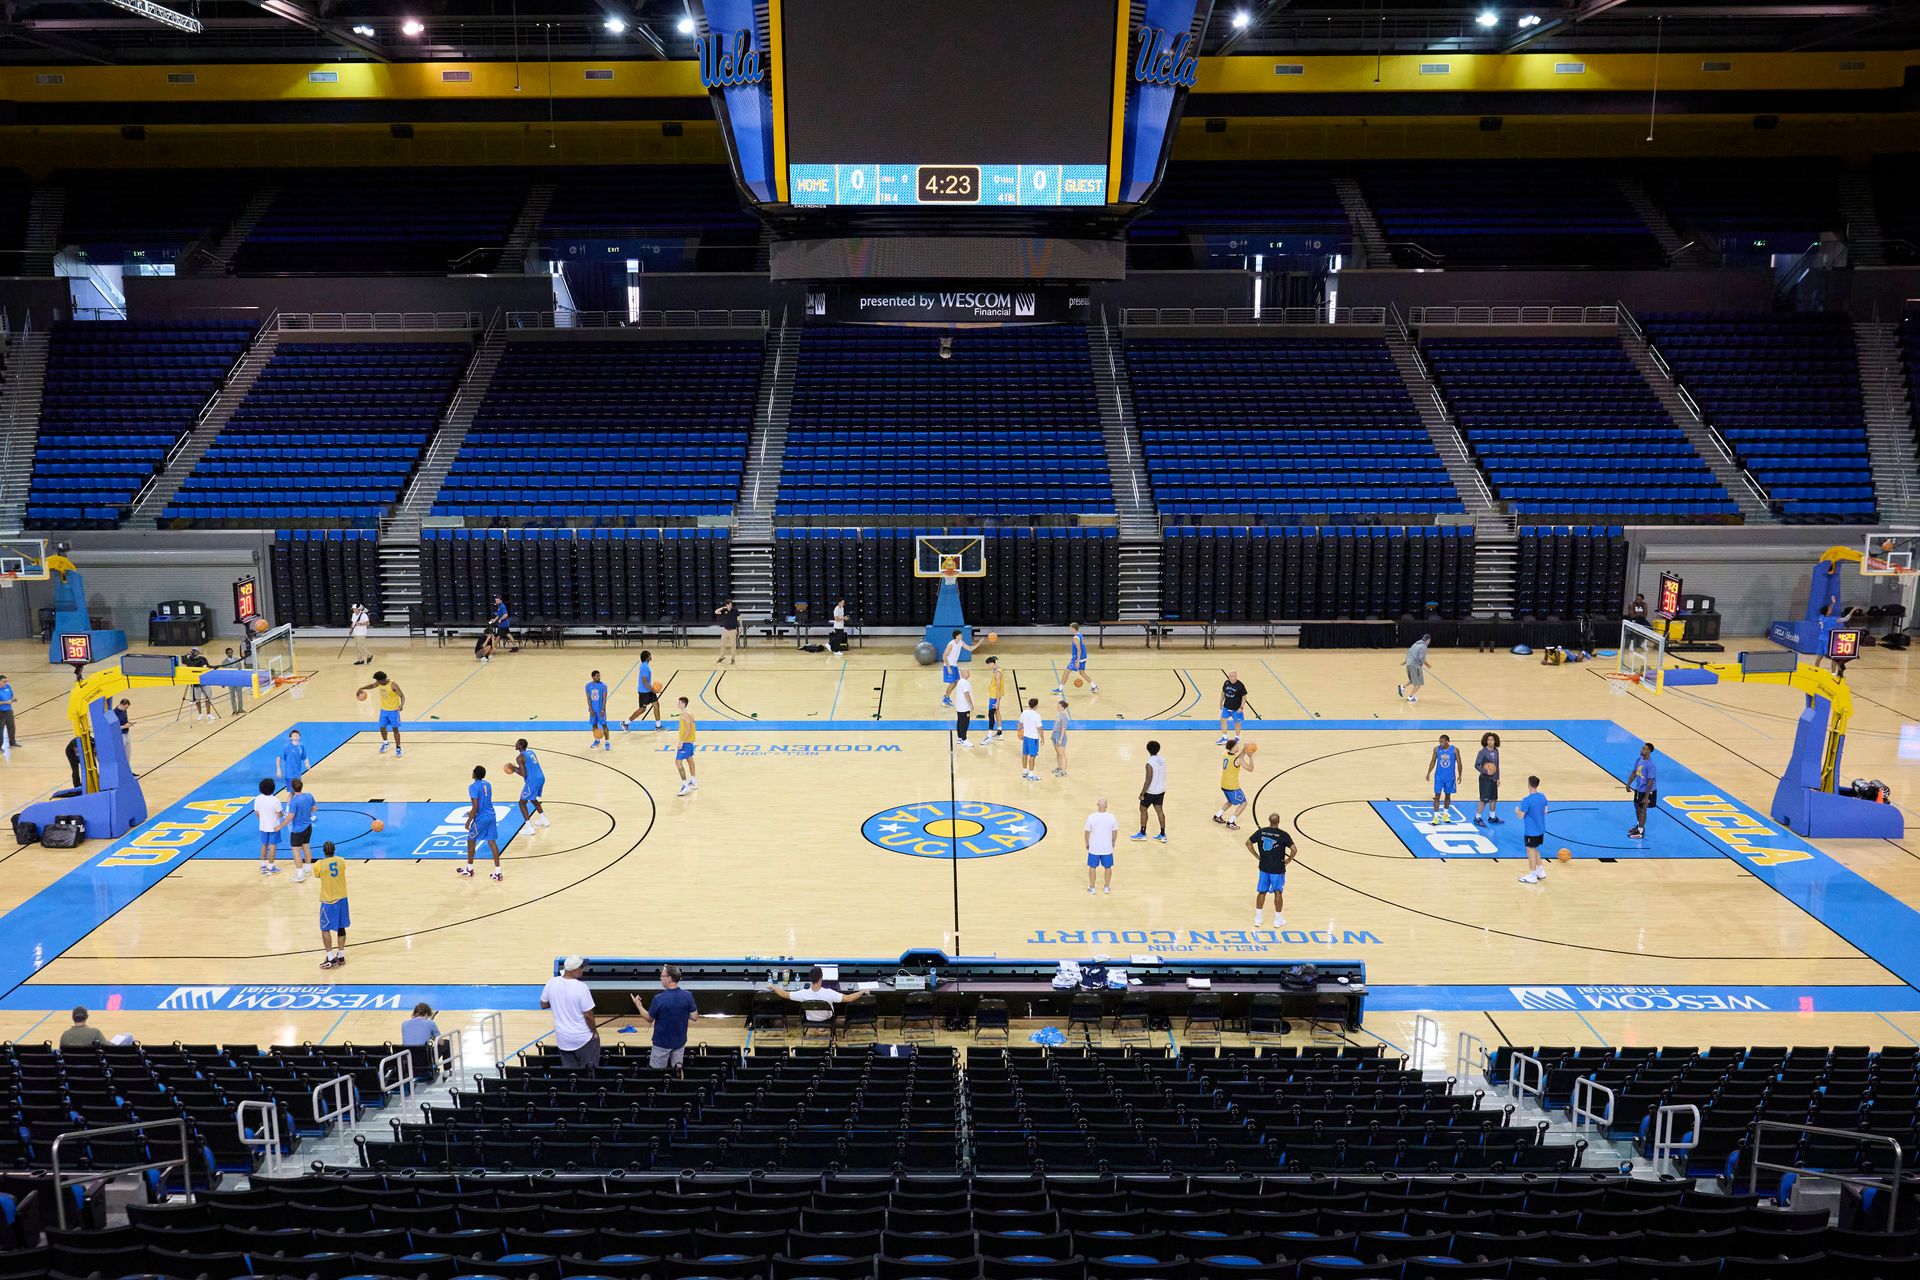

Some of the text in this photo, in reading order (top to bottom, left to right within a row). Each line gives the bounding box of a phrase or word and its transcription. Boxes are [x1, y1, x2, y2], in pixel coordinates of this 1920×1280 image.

[797, 179, 830, 192] HOME
[851, 170, 864, 189] 0
[925, 174, 971, 195] 4:23
[1033, 170, 1047, 190] 0
[1065, 179, 1102, 192] GUEST
[860, 292, 1011, 310] presented by WESCOM
[974, 308, 1011, 316] Financial
[240, 595, 252, 617] 30
[1664, 591, 1676, 613] 30
[69, 646, 84, 658] 30
[1837, 643, 1851, 655] 30
[655, 744, 902, 752] WOODEN COUT
[1223, 758, 1229, 769] 0
[96, 796, 256, 867] UCLA
[1662, 795, 1815, 866] UCLA
[329, 861, 339, 878] 5
[1027, 931, 1384, 944] WOODEN COURT
[240, 986, 332, 995] Financial
[1576, 987, 1670, 995] Financial
[227, 994, 402, 1010] WESCOM
[1580, 994, 1771, 1010] WESCOM
